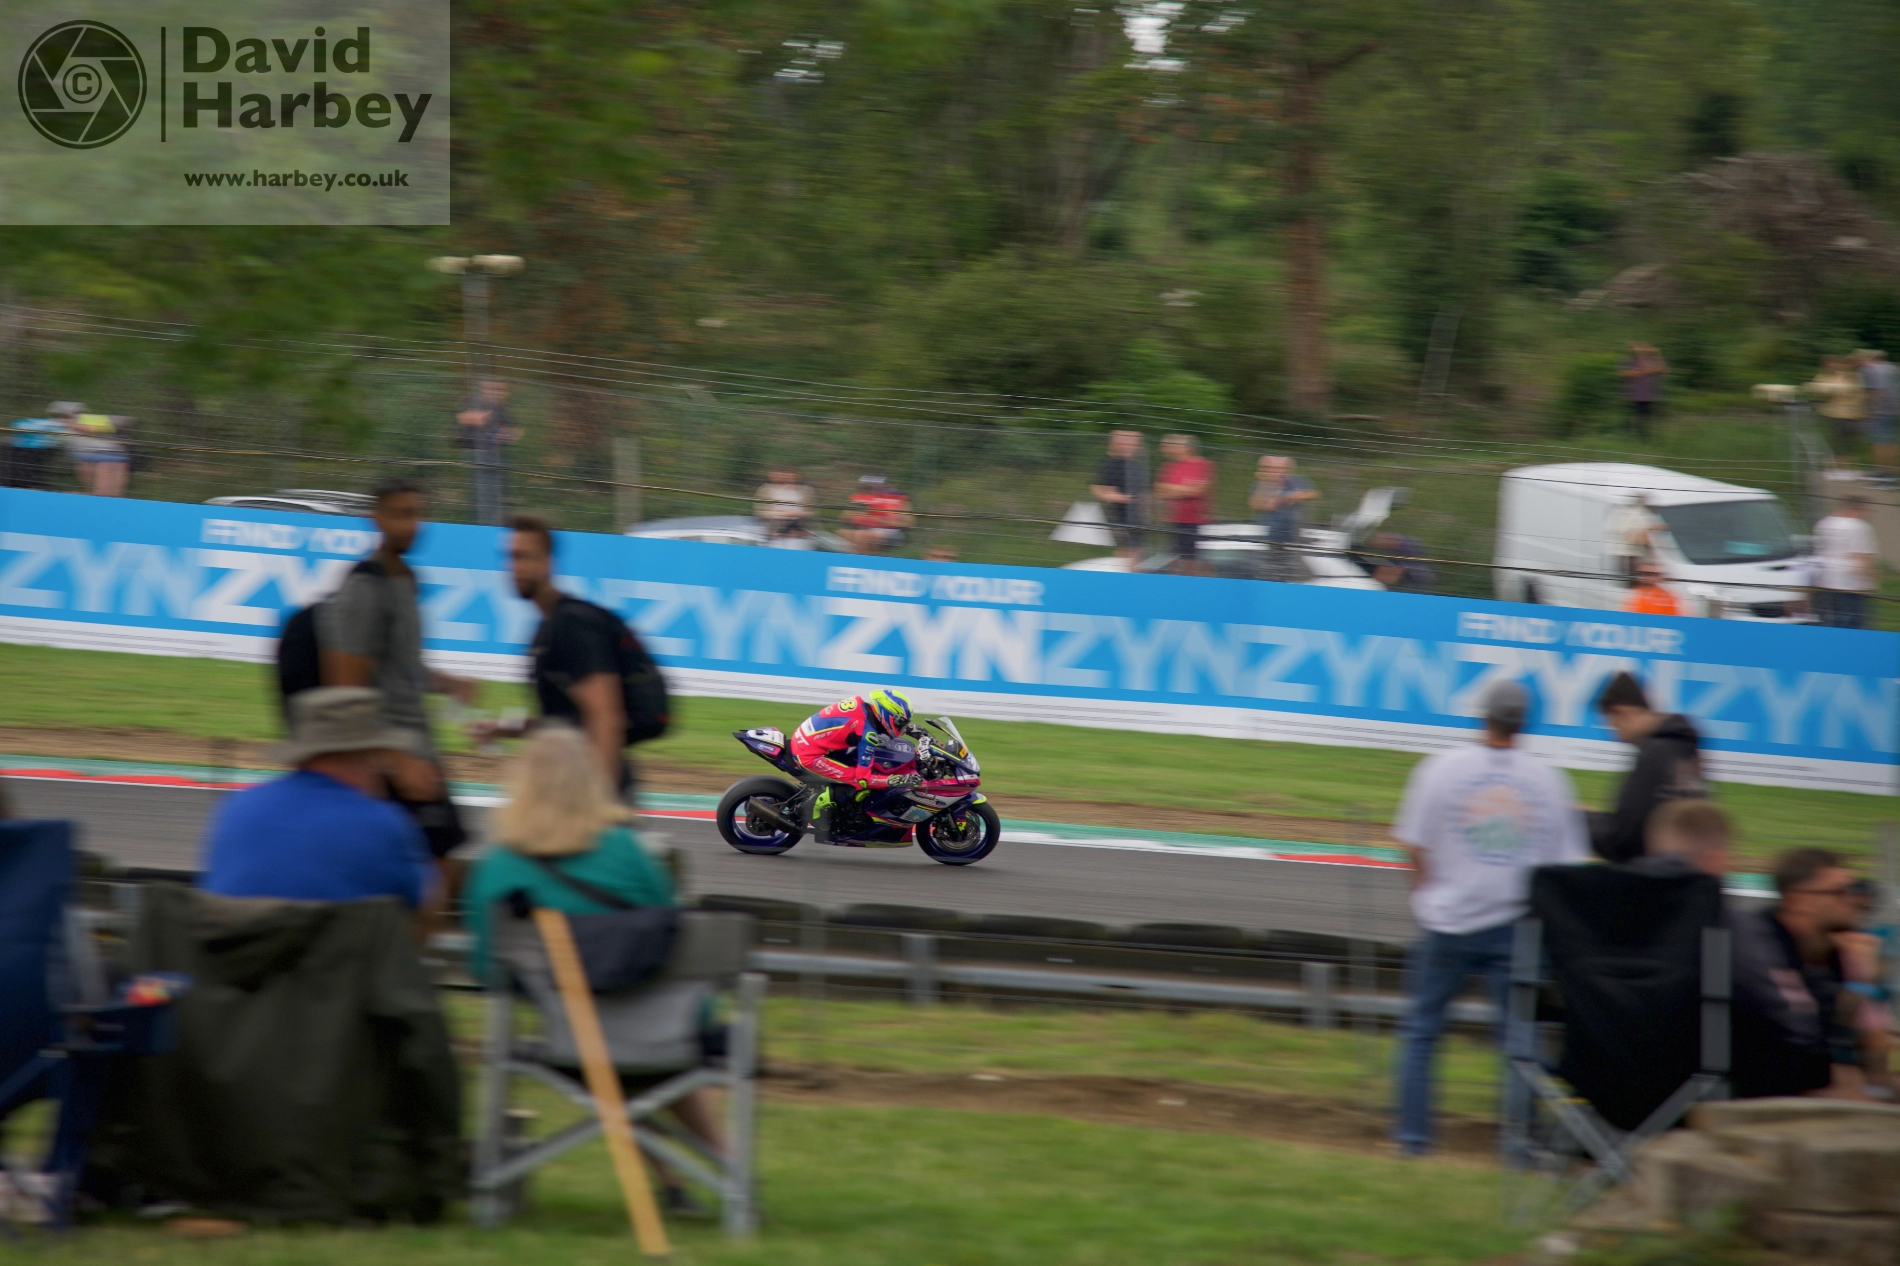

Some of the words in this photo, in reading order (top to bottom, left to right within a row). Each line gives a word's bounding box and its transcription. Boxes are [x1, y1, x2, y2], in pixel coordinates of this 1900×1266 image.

[201, 518, 303, 550] FIND
[825, 566, 926, 597] FIND
[929, 574, 1046, 606] YOUR
[0, 531, 208, 629] ZYN
[805, 595, 1046, 684] ZYN
[1043, 612, 1248, 697] ZYN
[1232, 623, 1456, 715] ZYN
[1456, 611, 1561, 644] FIND
[1565, 620, 1687, 655] YOUR
